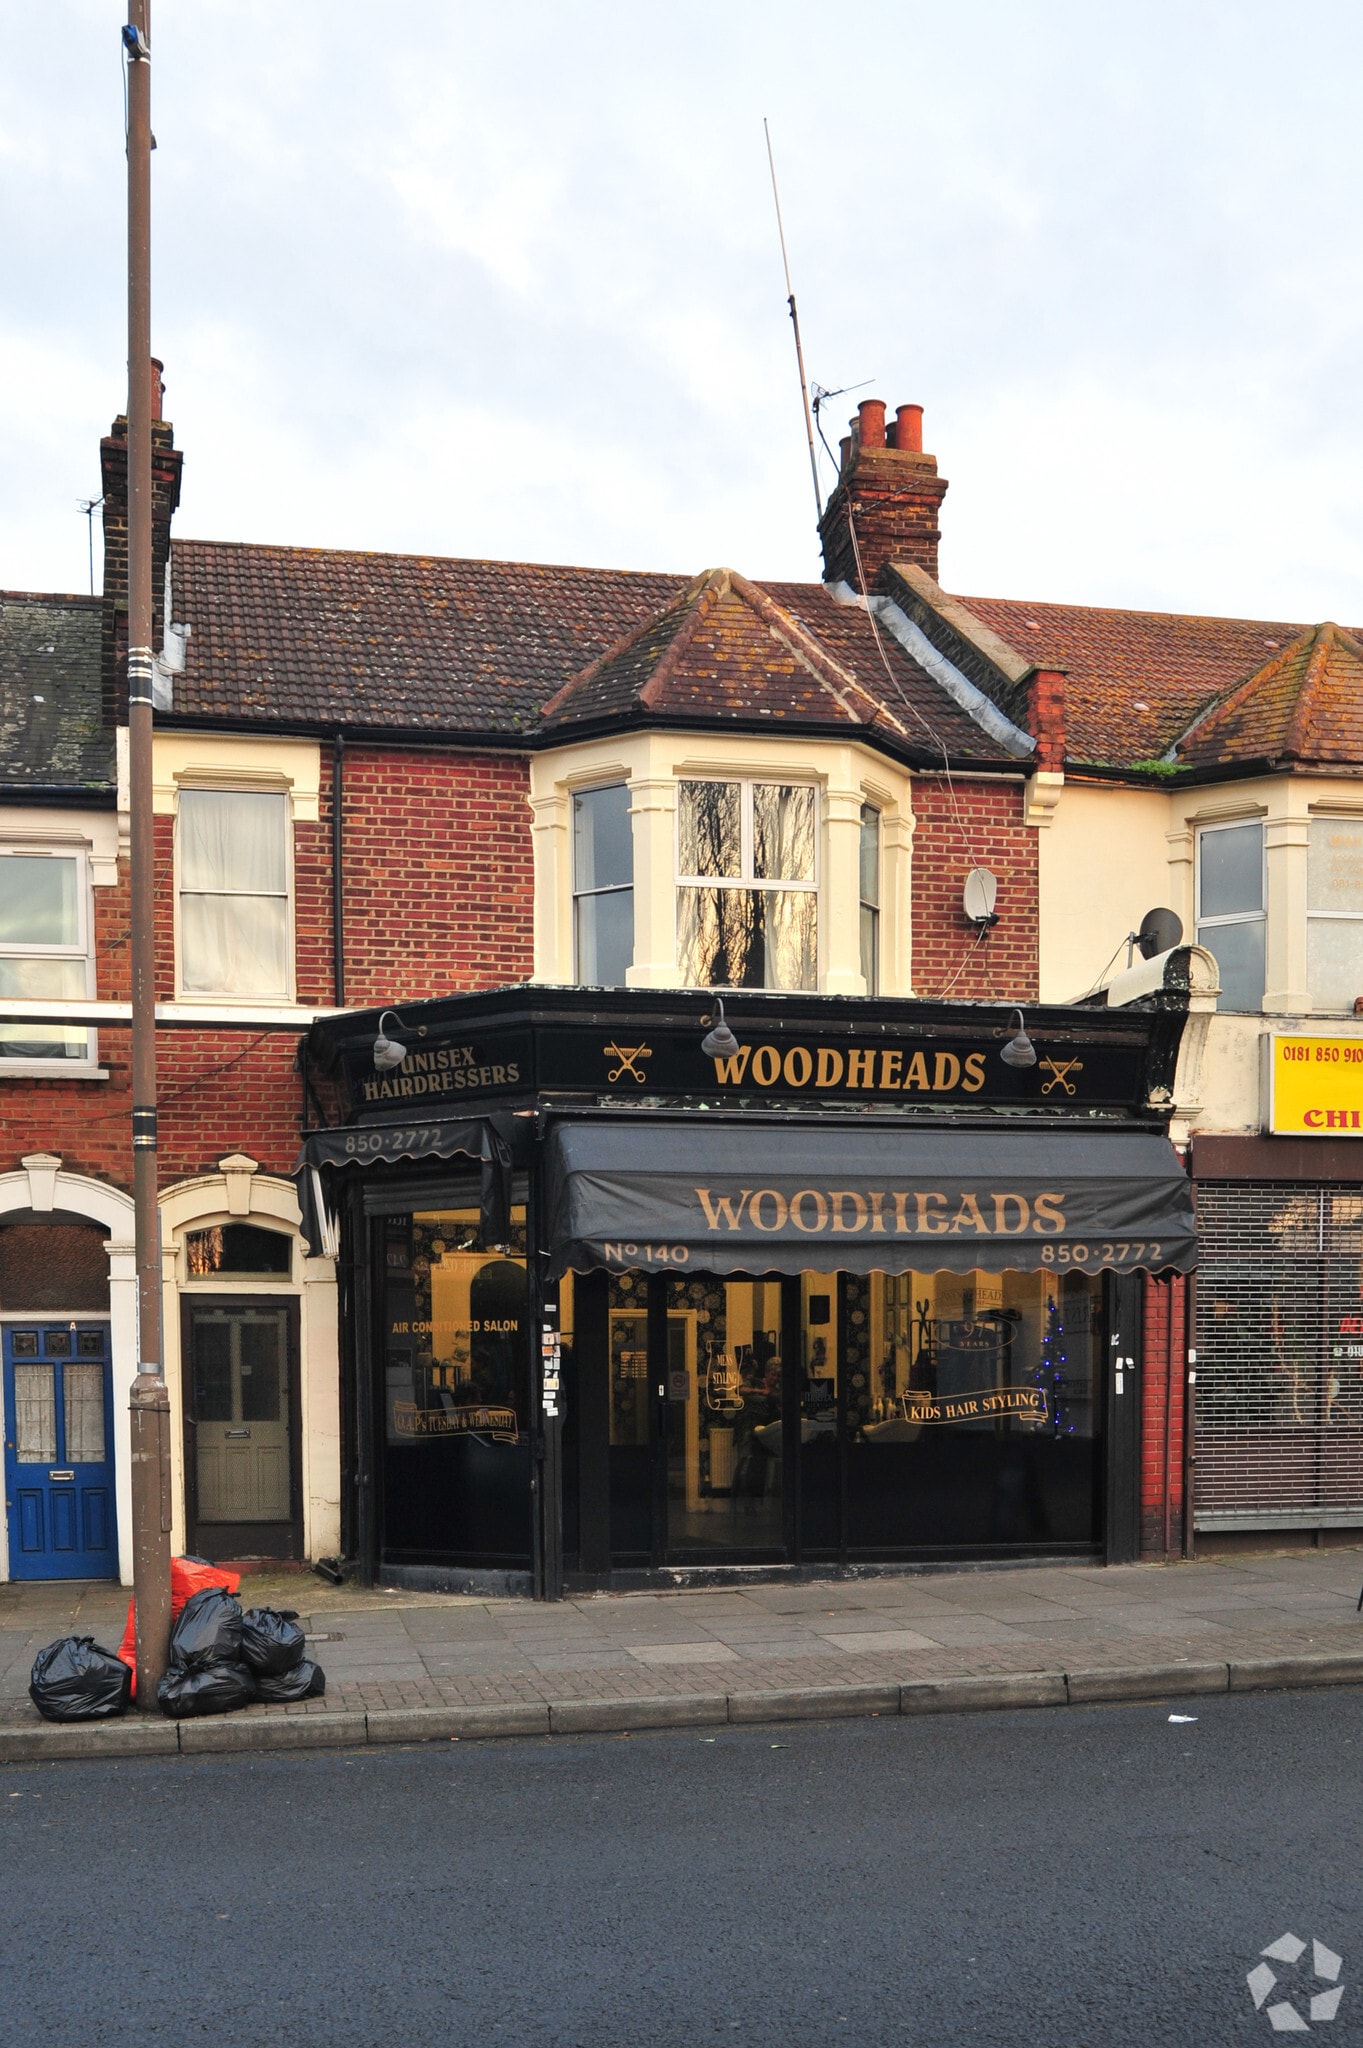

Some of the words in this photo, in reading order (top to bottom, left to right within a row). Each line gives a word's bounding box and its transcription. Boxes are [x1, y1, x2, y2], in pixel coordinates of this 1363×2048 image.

[401, 1046, 476, 1074] UNISEX
[1283, 1046, 1310, 1061] 0181
[1316, 1047, 1339, 1062] 850
[713, 1045, 987, 1093] WOODHEADS
[364, 1063, 520, 1101] HAIRDRESSERS
[1303, 1109, 1361, 1128] CHI
[693, 1188, 1068, 1234] WOODHEADS
[644, 1244, 690, 1264] 140
[392, 1321, 409, 1334] AIR
[412, 1320, 480, 1333] CONDITIONED
[483, 1319, 518, 1332] SALON
[960, 1340, 990, 1348] YEARS
[910, 1406, 941, 1420] KIDS
[945, 1400, 979, 1418] HAIR
[982, 1393, 1040, 1412] STYLING
[429, 1413, 460, 1432] TUESDAY
[468, 1412, 514, 1429] WEDNESDAY
